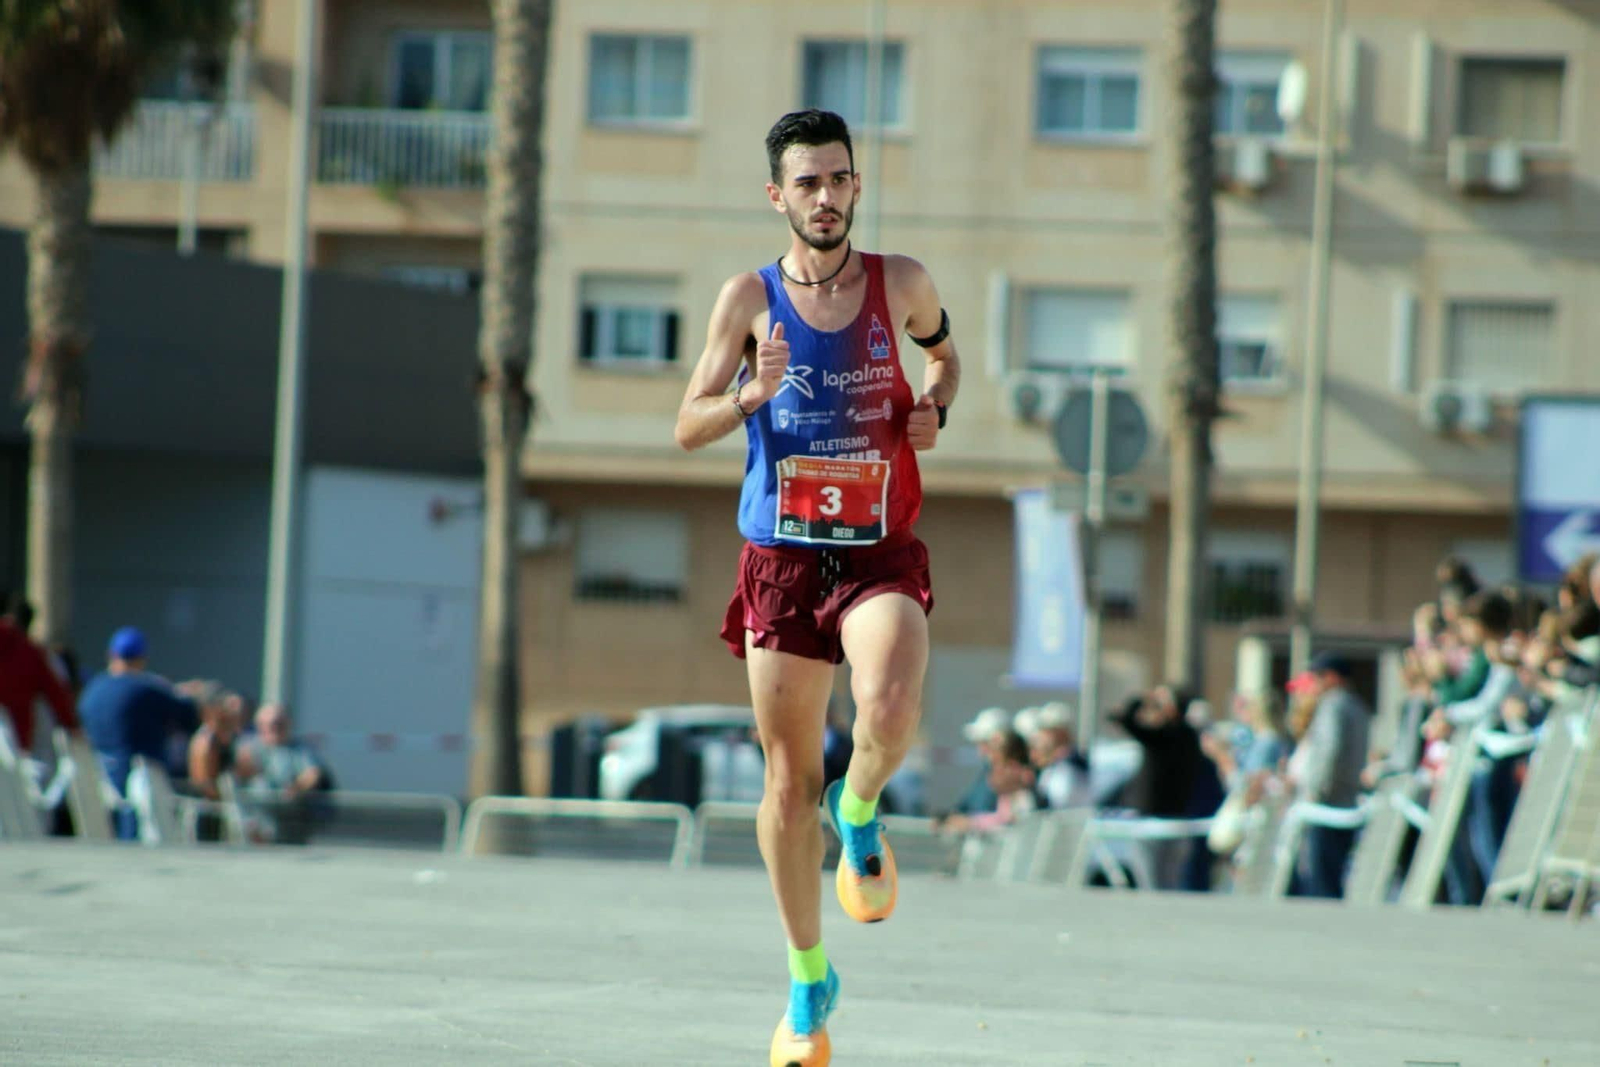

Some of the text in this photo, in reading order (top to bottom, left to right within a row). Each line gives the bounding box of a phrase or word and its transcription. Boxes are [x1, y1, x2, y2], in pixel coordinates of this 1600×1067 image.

[823, 363, 894, 392] lapalma
[846, 380, 893, 395] cooperativa
[809, 436, 869, 452] ATLETISMO
[818, 486, 842, 516] 3
[783, 520, 794, 532] 12
[832, 526, 855, 538] DIEGO
